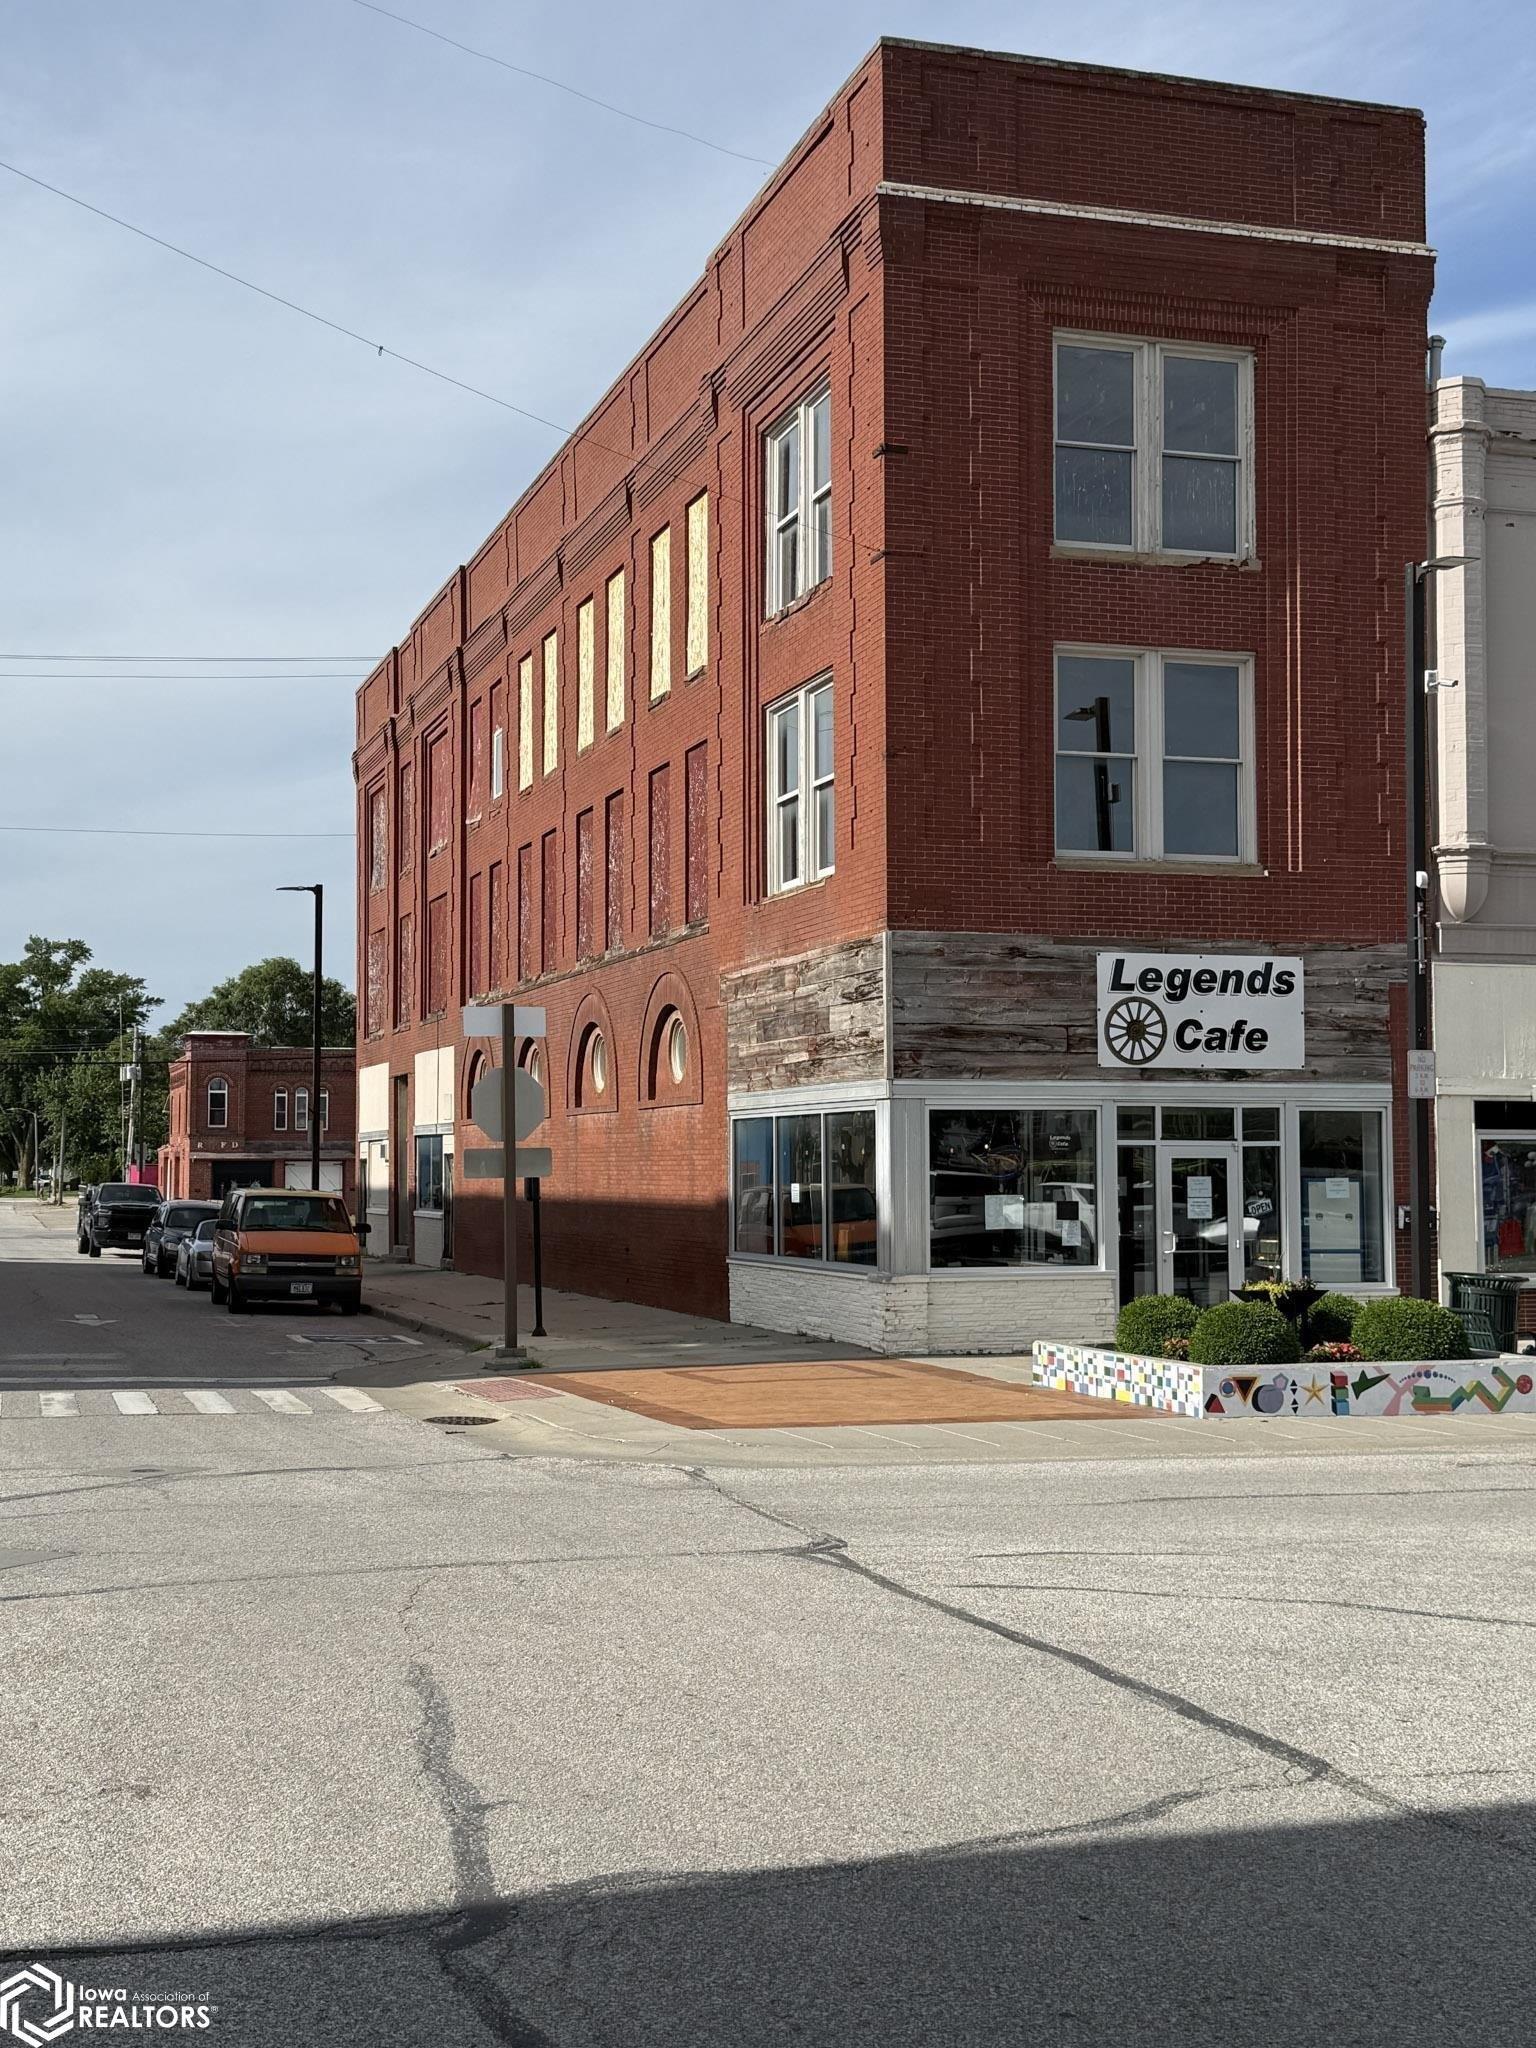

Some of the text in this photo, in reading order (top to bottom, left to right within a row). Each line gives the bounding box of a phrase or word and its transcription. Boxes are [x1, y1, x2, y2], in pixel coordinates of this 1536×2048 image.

[1108, 958, 1296, 1004] Legends
[1174, 1018, 1269, 1054] Cafe
[1251, 1202, 1271, 1215] OPEN
